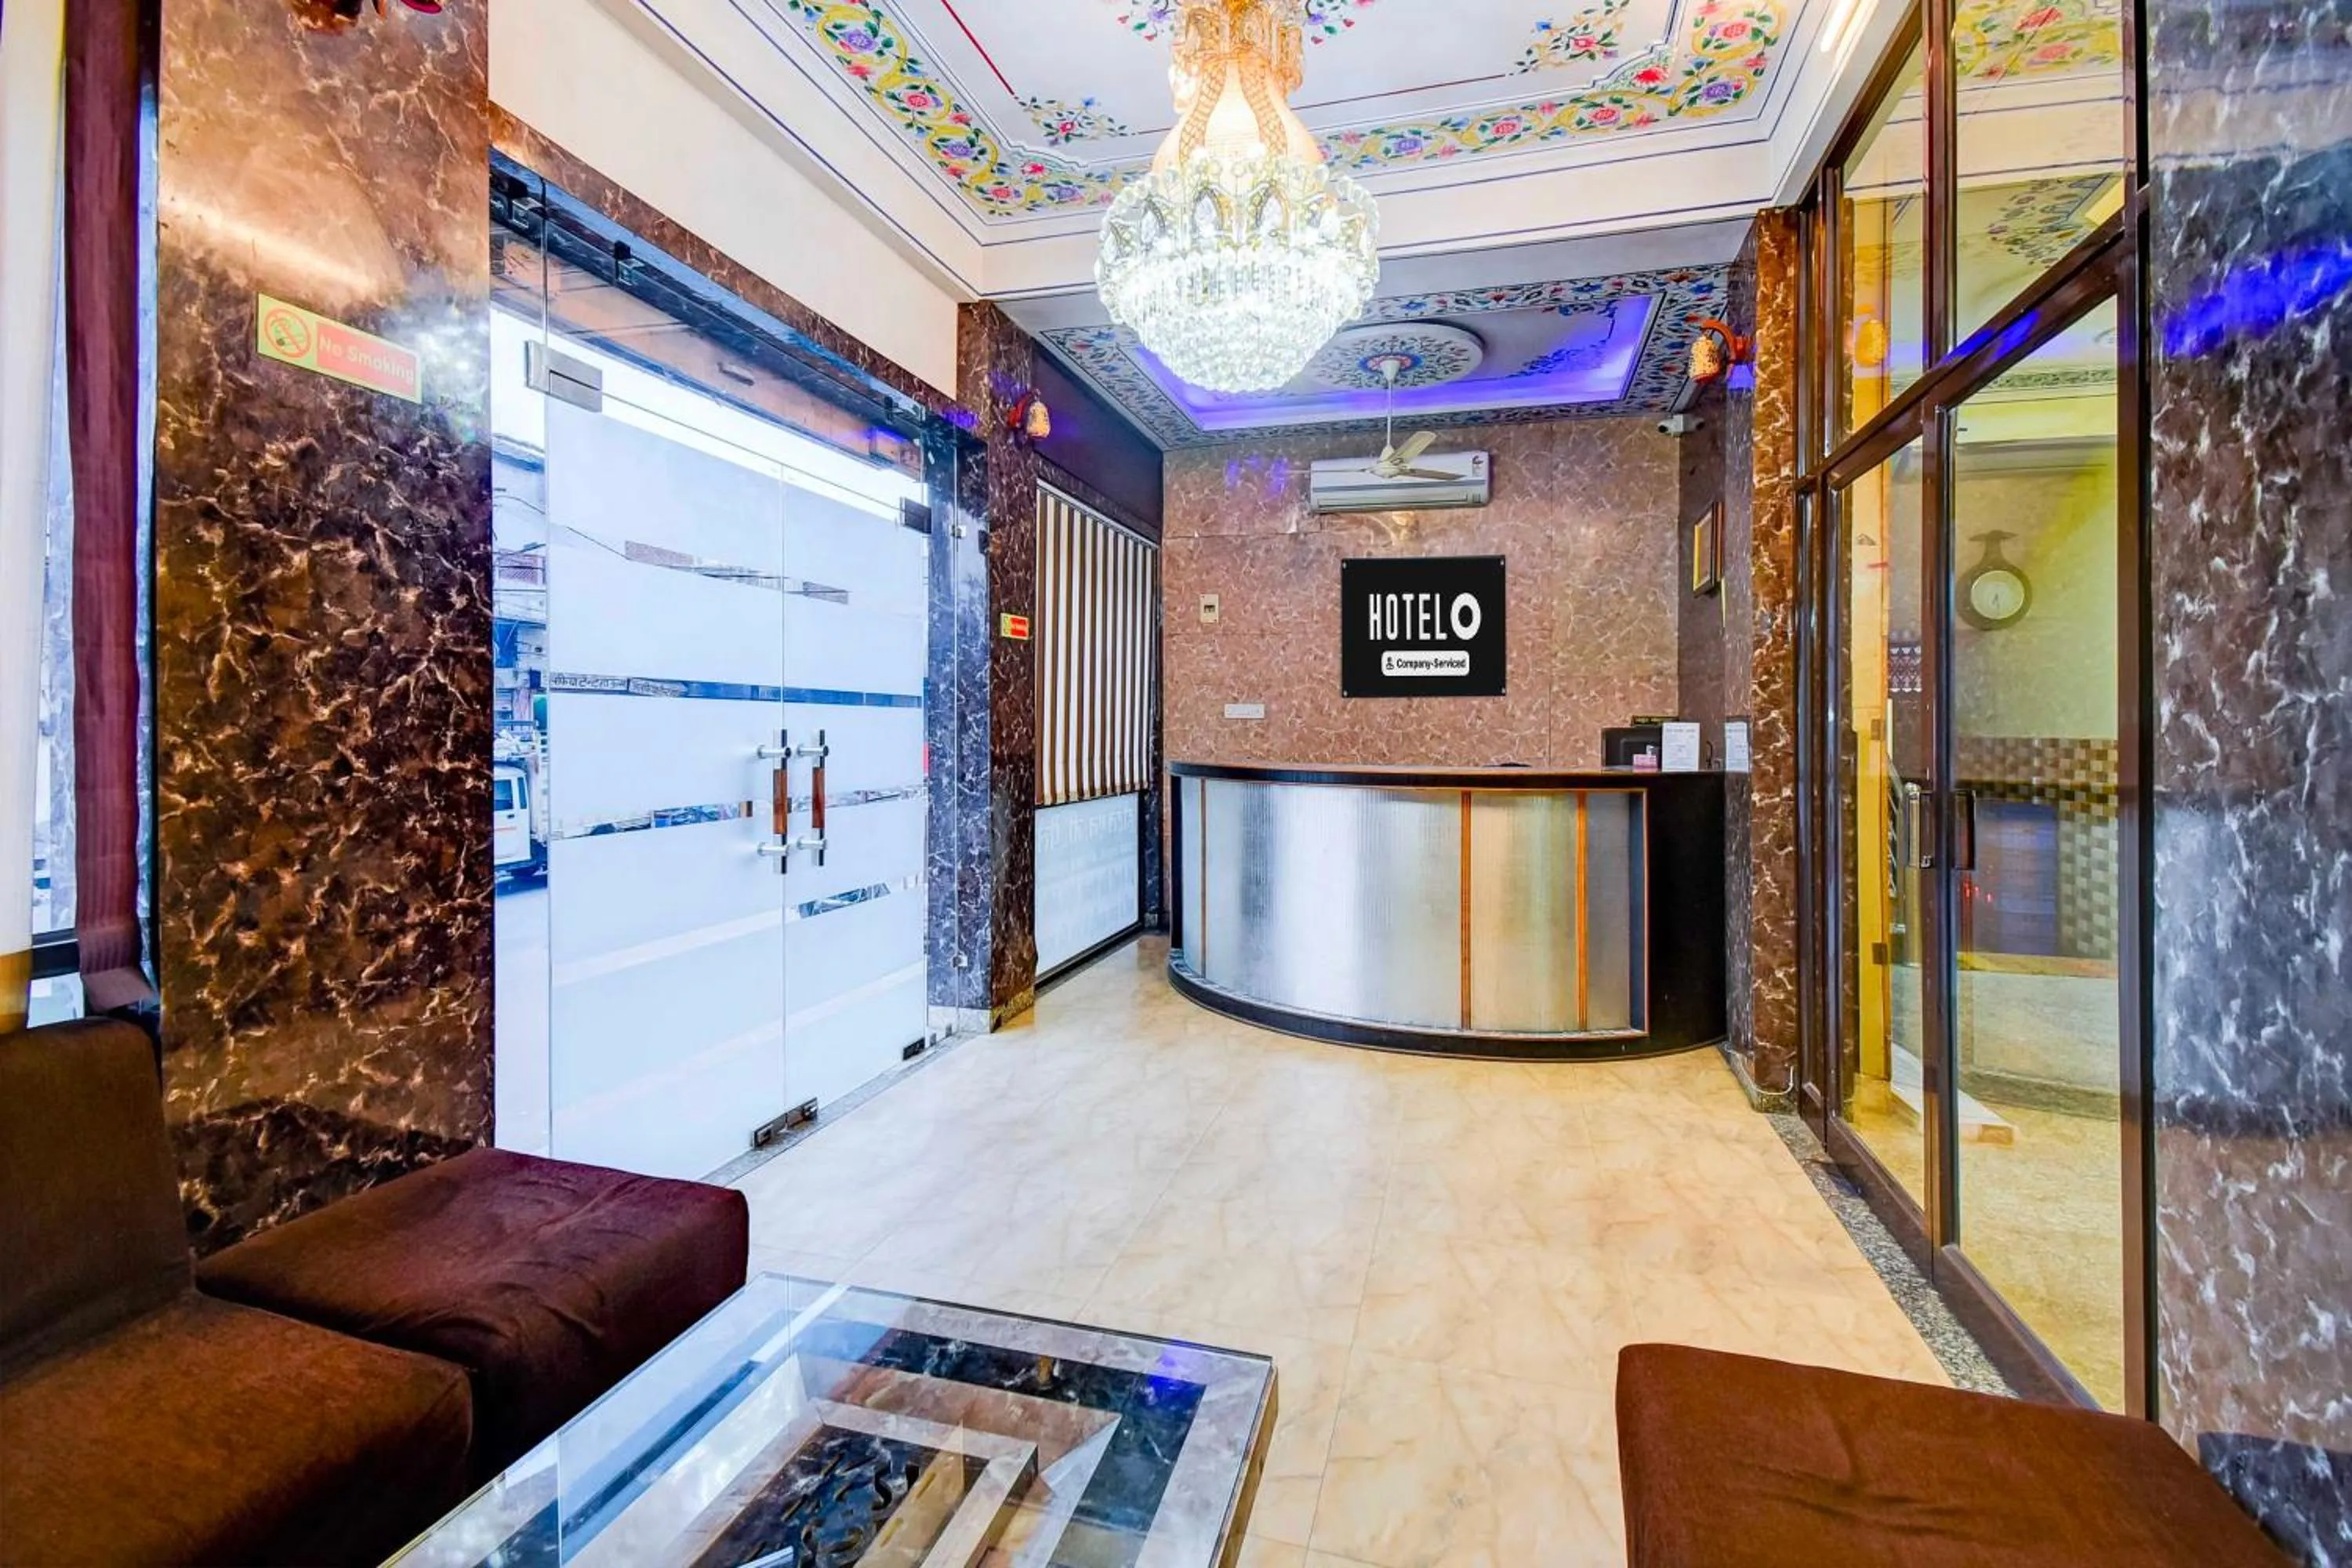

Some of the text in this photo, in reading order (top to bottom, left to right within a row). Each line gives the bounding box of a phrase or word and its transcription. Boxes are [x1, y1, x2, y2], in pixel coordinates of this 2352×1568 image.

[319, 333, 414, 385] No Smoking
[1396, 658, 1466, 670] Company-Serviced
